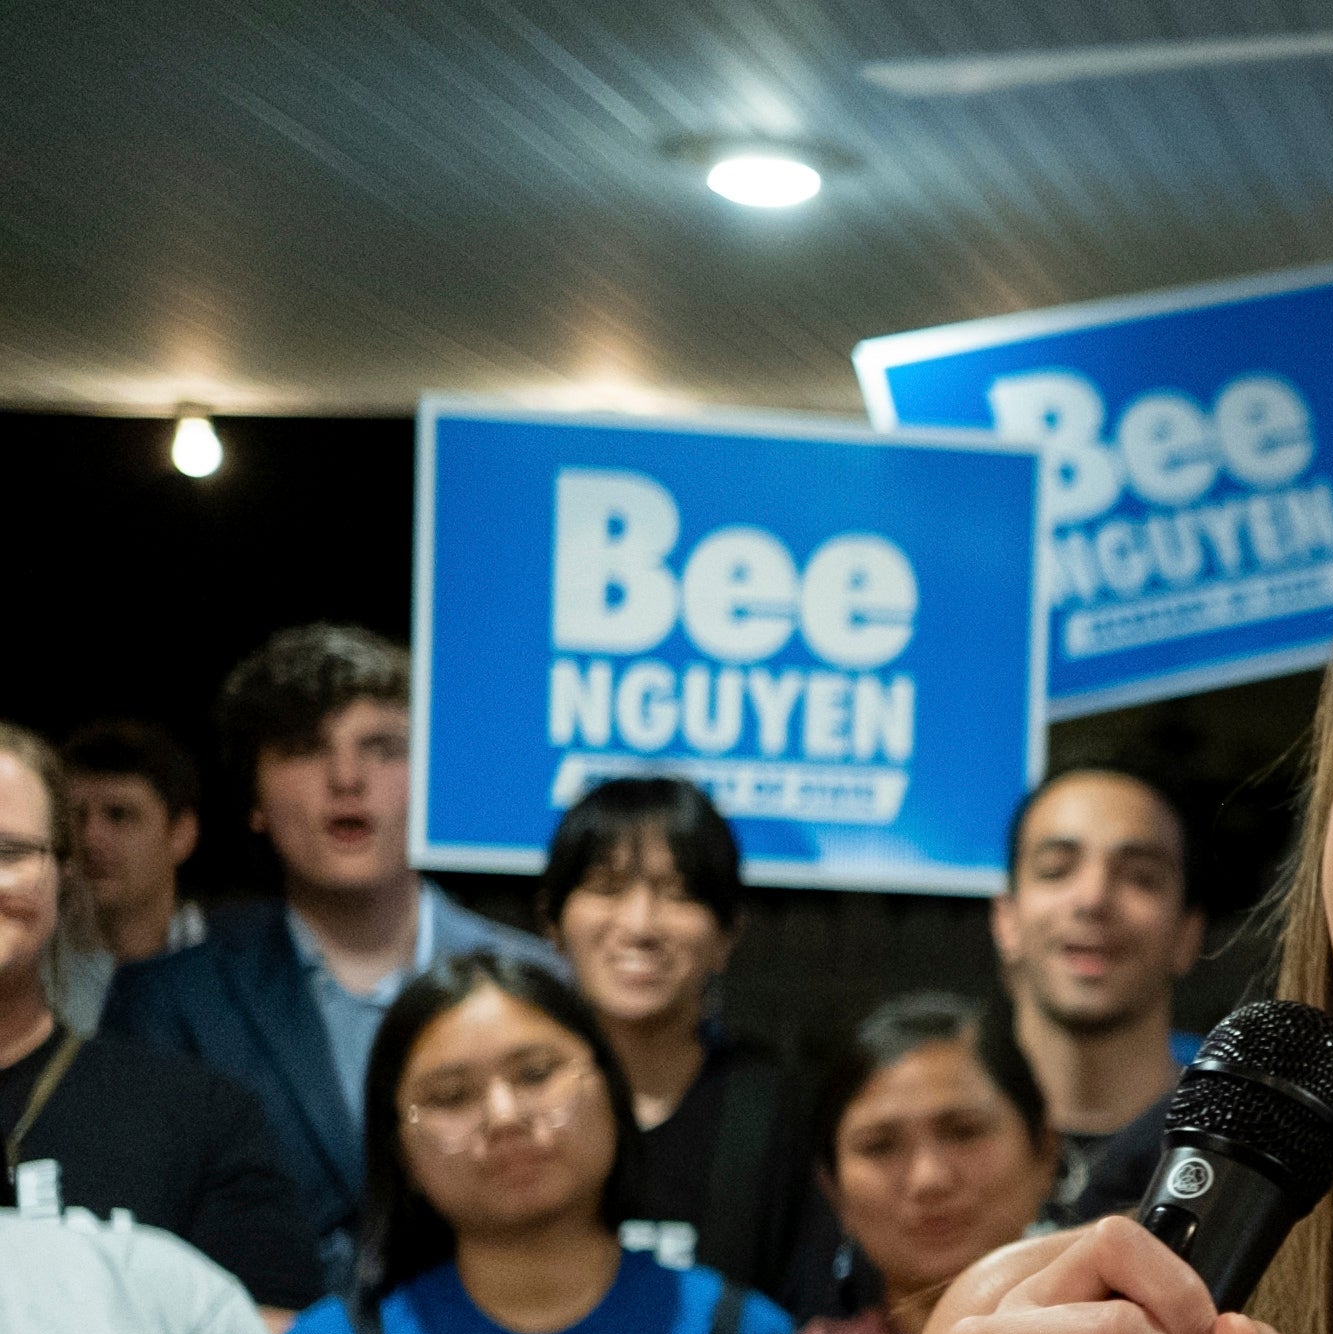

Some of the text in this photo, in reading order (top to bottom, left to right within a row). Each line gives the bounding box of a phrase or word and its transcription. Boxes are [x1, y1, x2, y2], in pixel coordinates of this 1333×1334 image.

[990, 365, 1316, 532] Bee
[552, 465, 918, 670] Bee
[548, 657, 915, 761] NGUYEN
